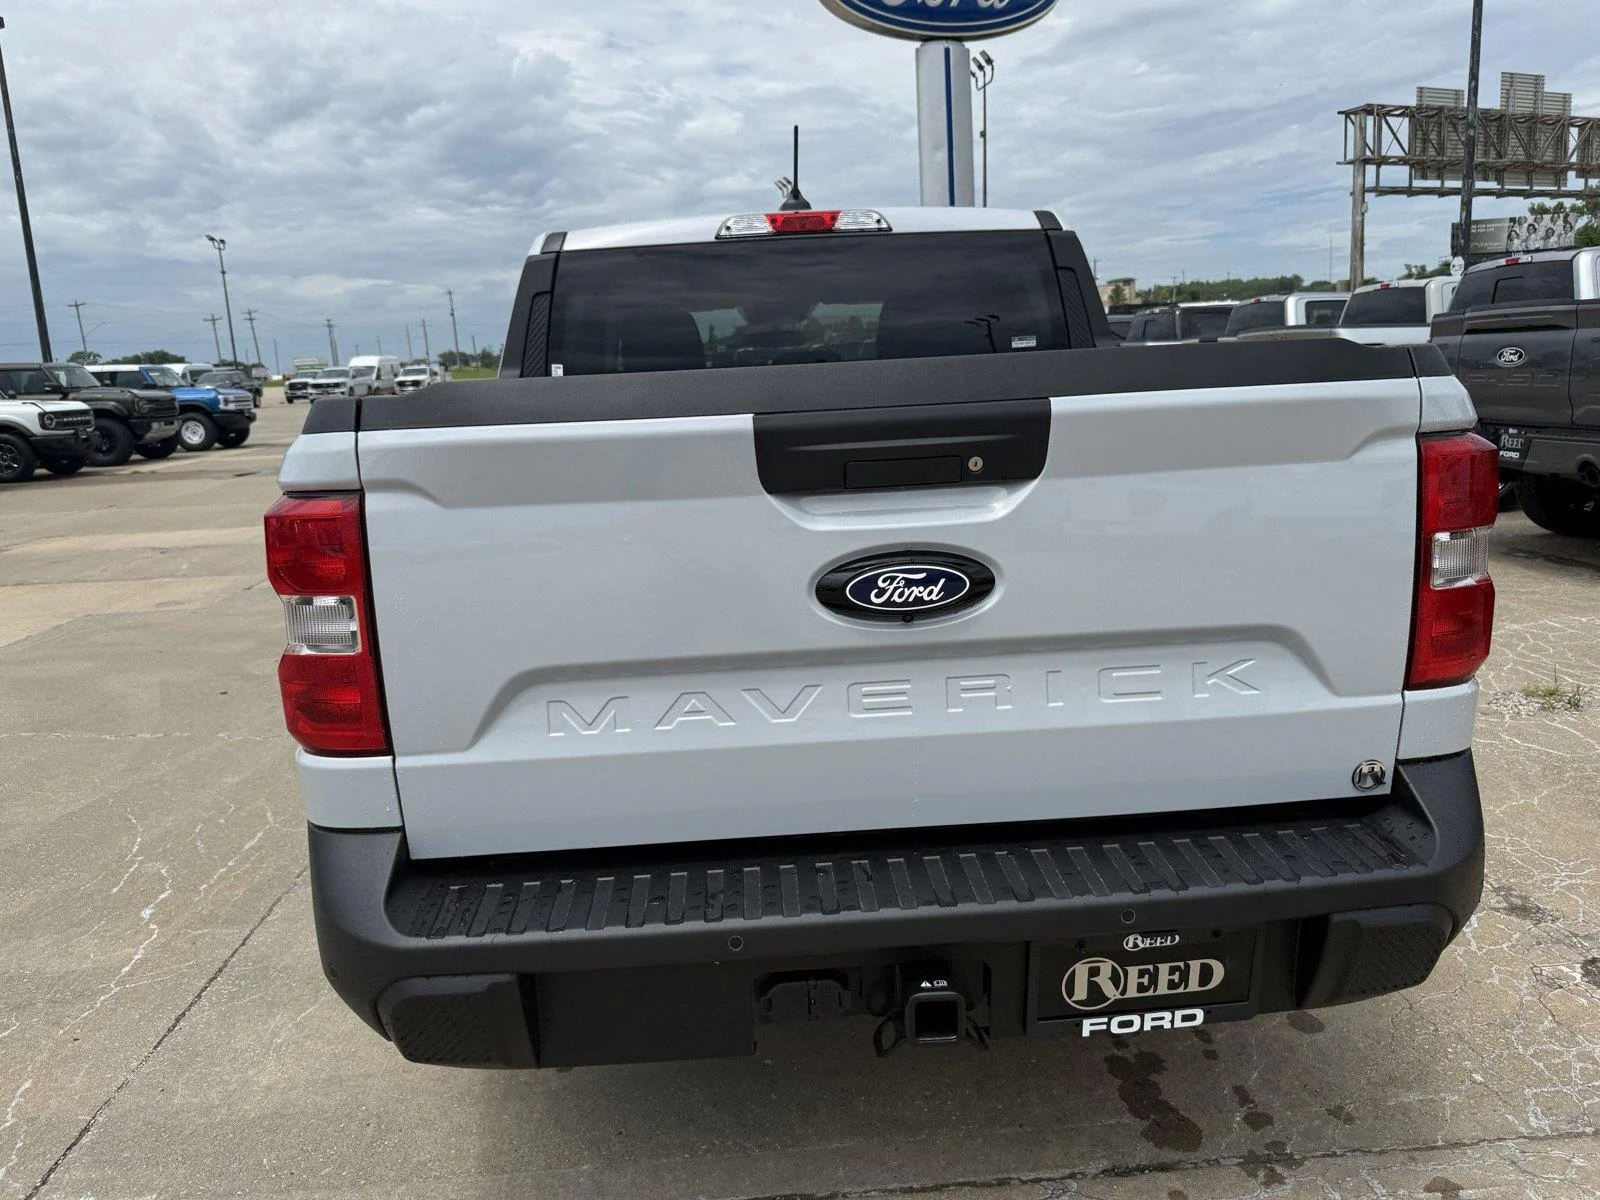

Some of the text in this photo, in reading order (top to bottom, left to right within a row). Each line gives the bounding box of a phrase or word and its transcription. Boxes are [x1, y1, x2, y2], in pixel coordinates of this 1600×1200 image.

[1500, 349, 1520, 362] Ford
[1499, 450, 1520, 459] FORD
[870, 572, 947, 604] Ford
[546, 658, 1262, 737] MAVERICK
[1125, 934, 1180, 950] REED
[1064, 957, 1225, 1005] REED
[1082, 1008, 1204, 1037] FORD
